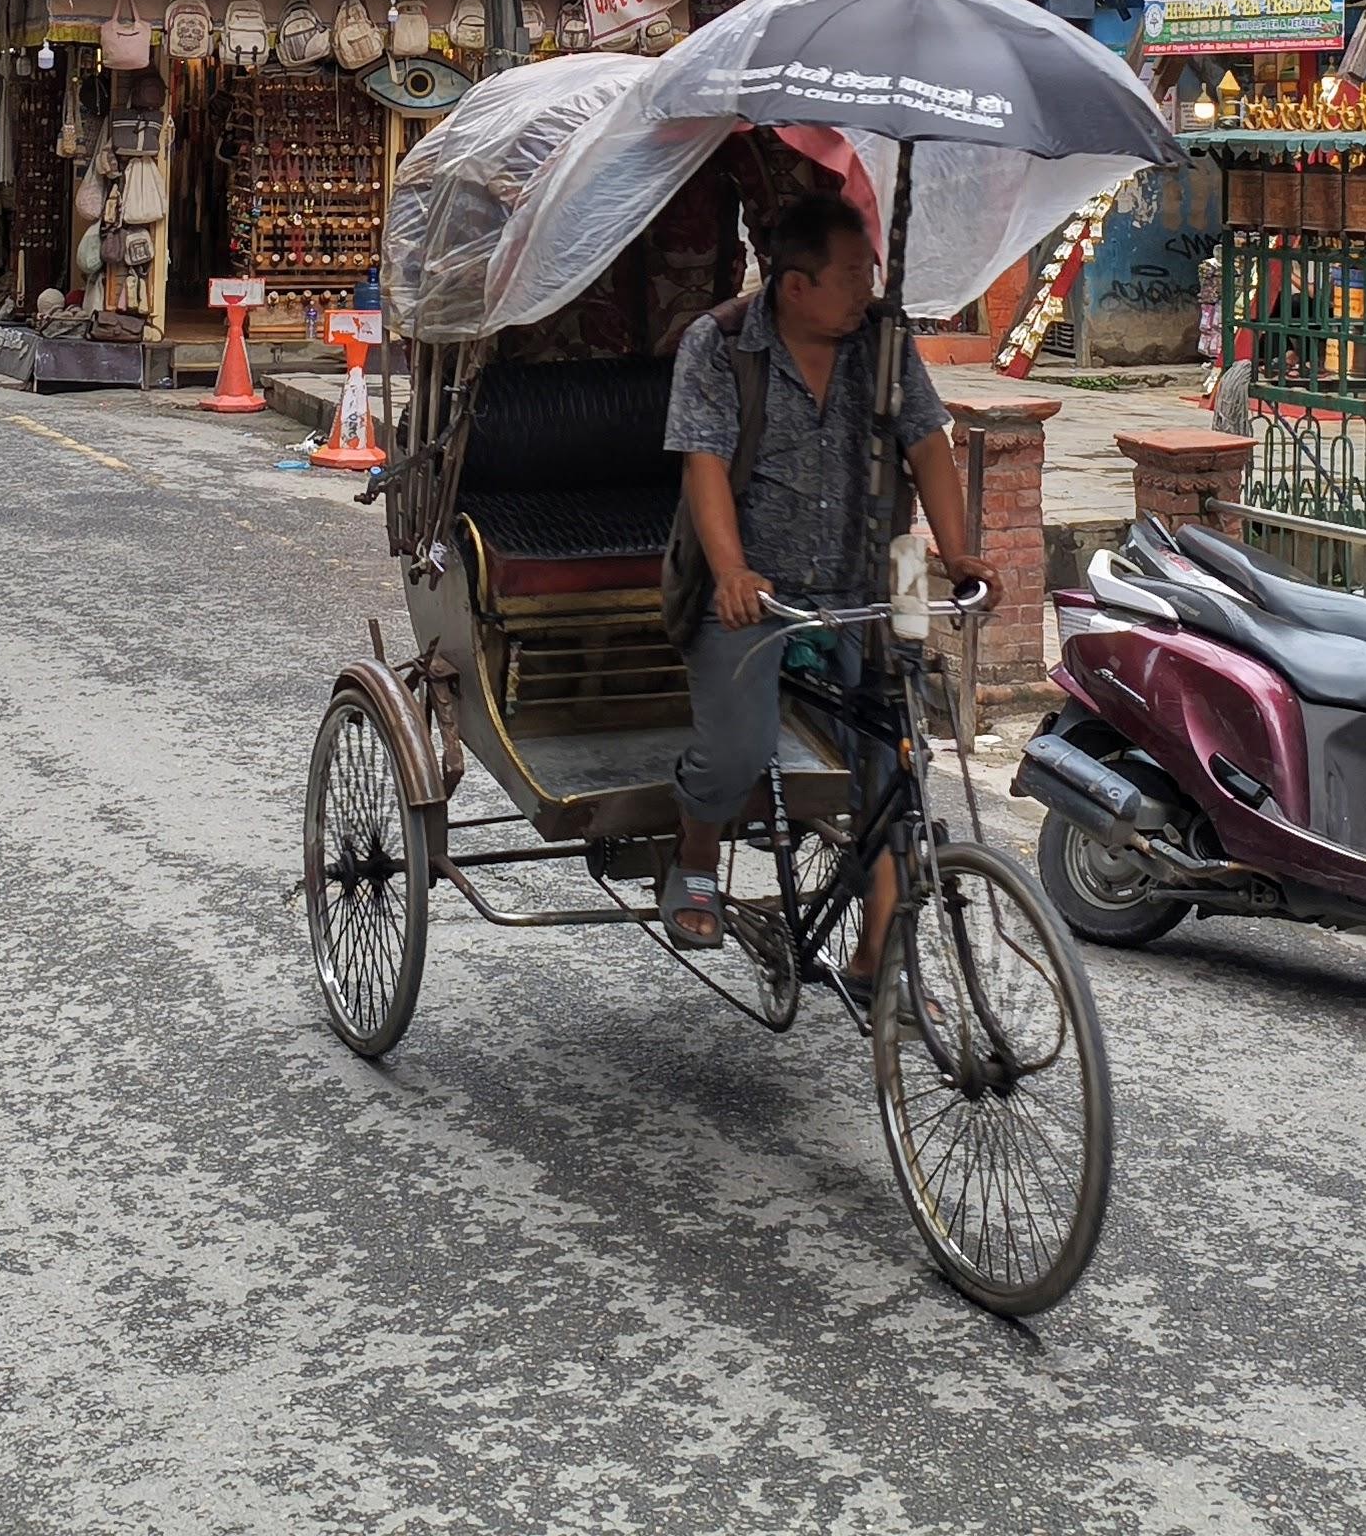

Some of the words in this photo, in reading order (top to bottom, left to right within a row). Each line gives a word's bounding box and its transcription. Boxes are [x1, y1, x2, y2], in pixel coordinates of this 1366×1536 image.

[1164, 0, 1231, 20] HIMALAYA
[803, 87, 856, 104] CHILD
[854, 93, 891, 105] SEX
[891, 93, 1005, 129] TRAFFICKING
